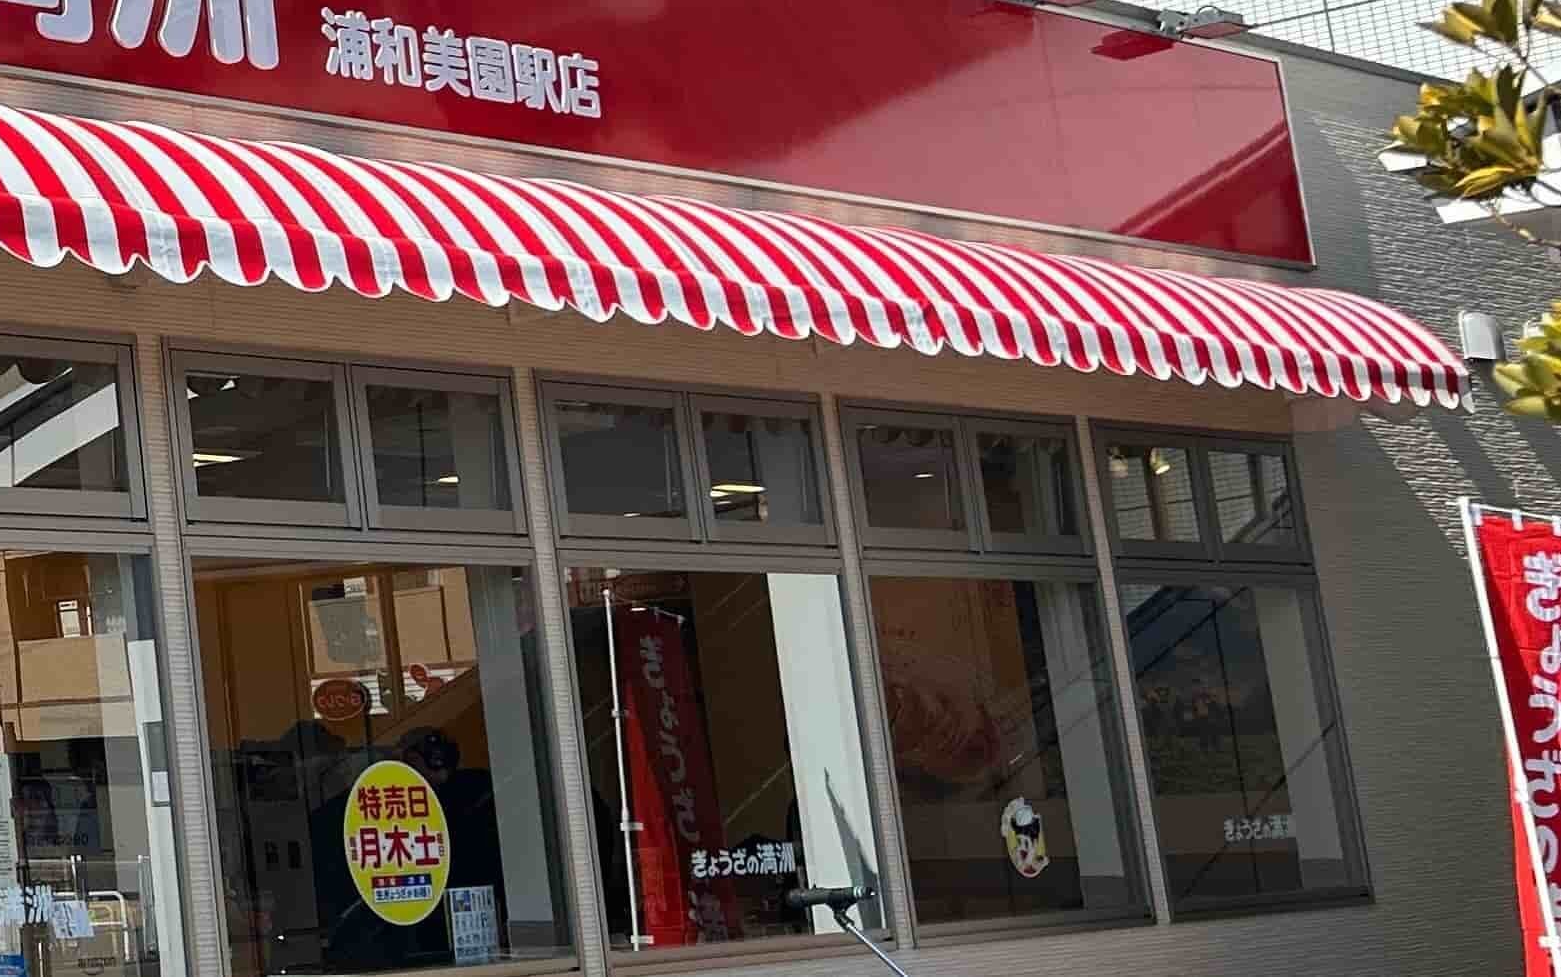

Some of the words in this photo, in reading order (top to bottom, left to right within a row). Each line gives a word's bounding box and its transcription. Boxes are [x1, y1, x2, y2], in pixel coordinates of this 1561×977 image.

[320, 6, 602, 119] 浦和美園駅店
[357, 784, 429, 821] 特売日
